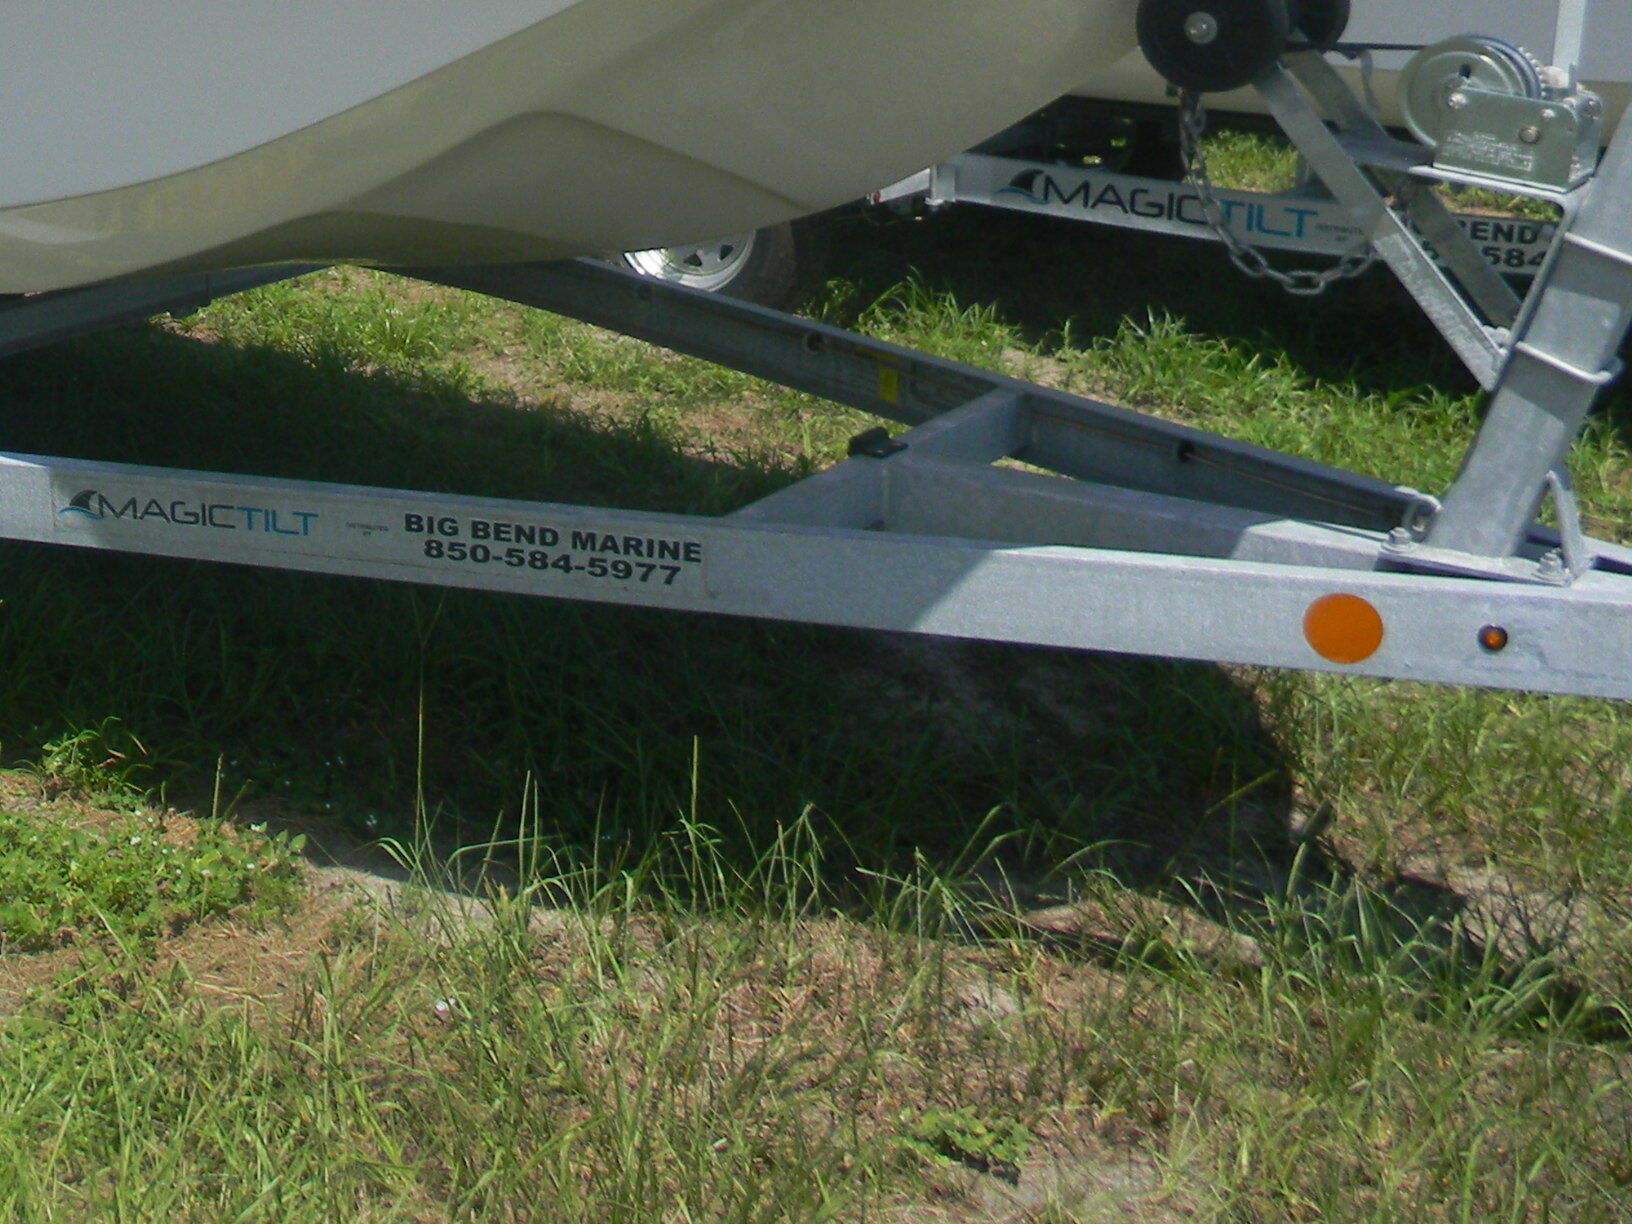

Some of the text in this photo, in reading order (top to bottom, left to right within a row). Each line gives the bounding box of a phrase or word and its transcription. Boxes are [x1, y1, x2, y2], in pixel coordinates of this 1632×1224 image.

[404, 513, 459, 536] BIG
[471, 520, 559, 547] BEND
[571, 530, 702, 563] MARINE
[424, 539, 682, 585] 850-584-5977
